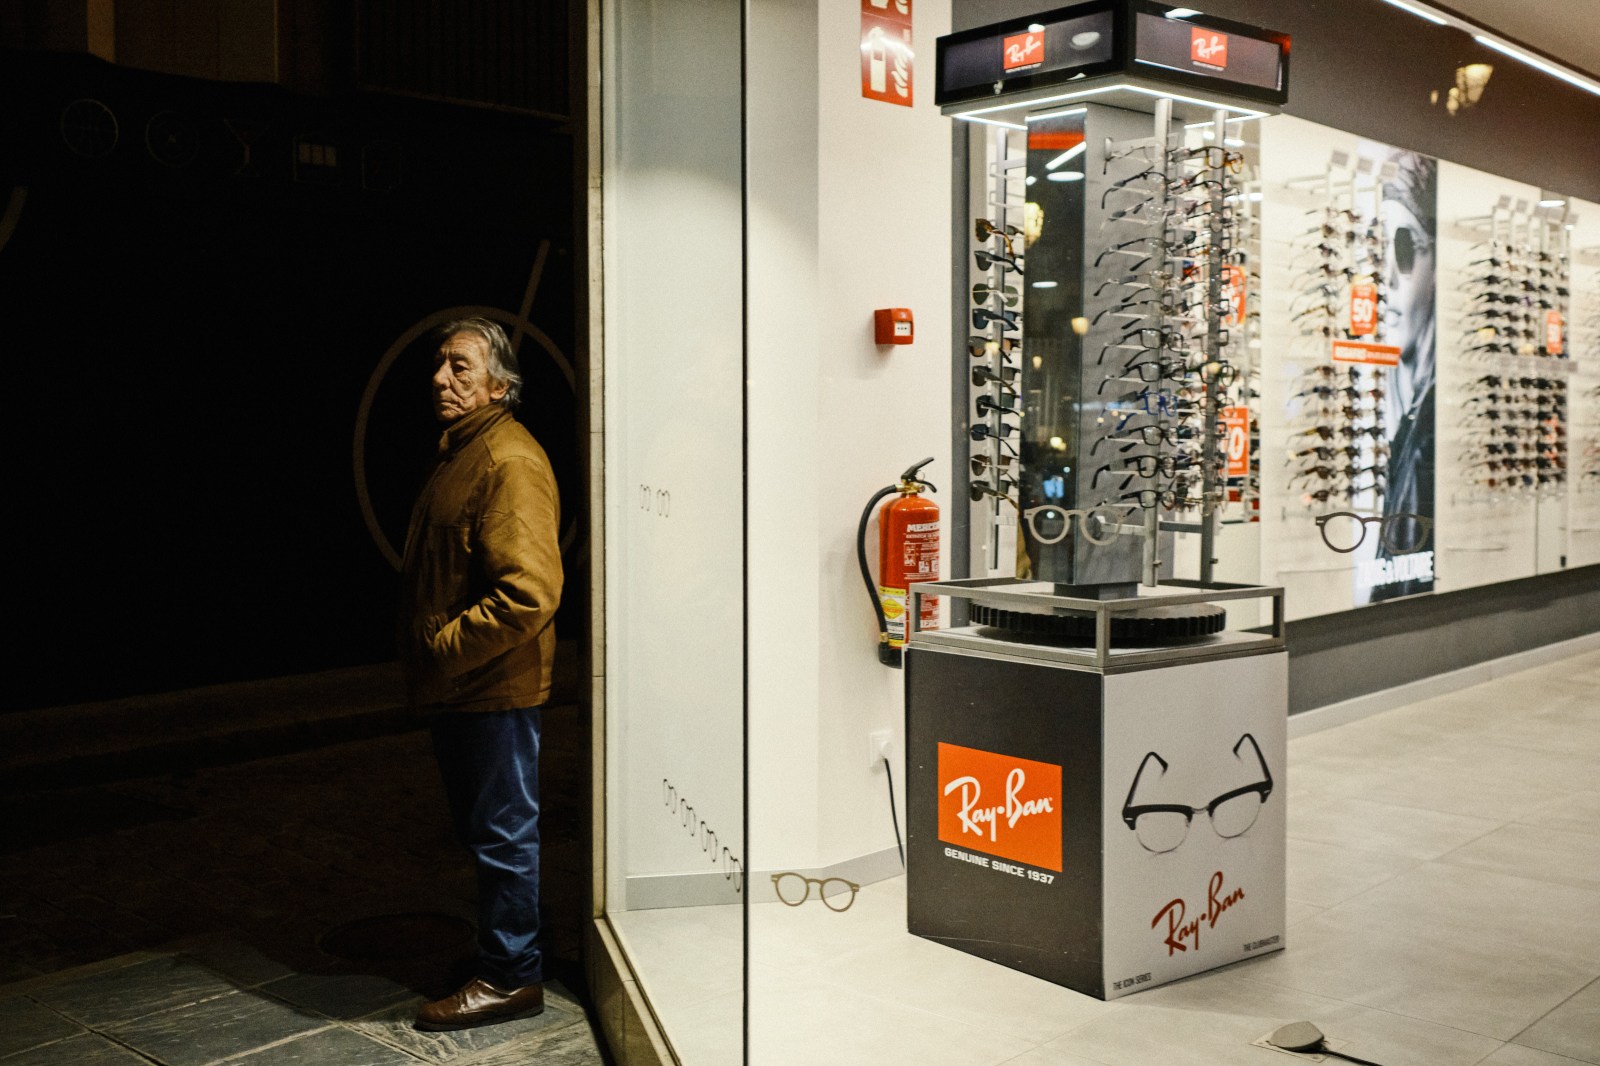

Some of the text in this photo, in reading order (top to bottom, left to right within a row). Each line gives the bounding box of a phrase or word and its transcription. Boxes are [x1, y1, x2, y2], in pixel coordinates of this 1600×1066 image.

[944, 847, 1055, 885] GENUINE SINCE 1937
